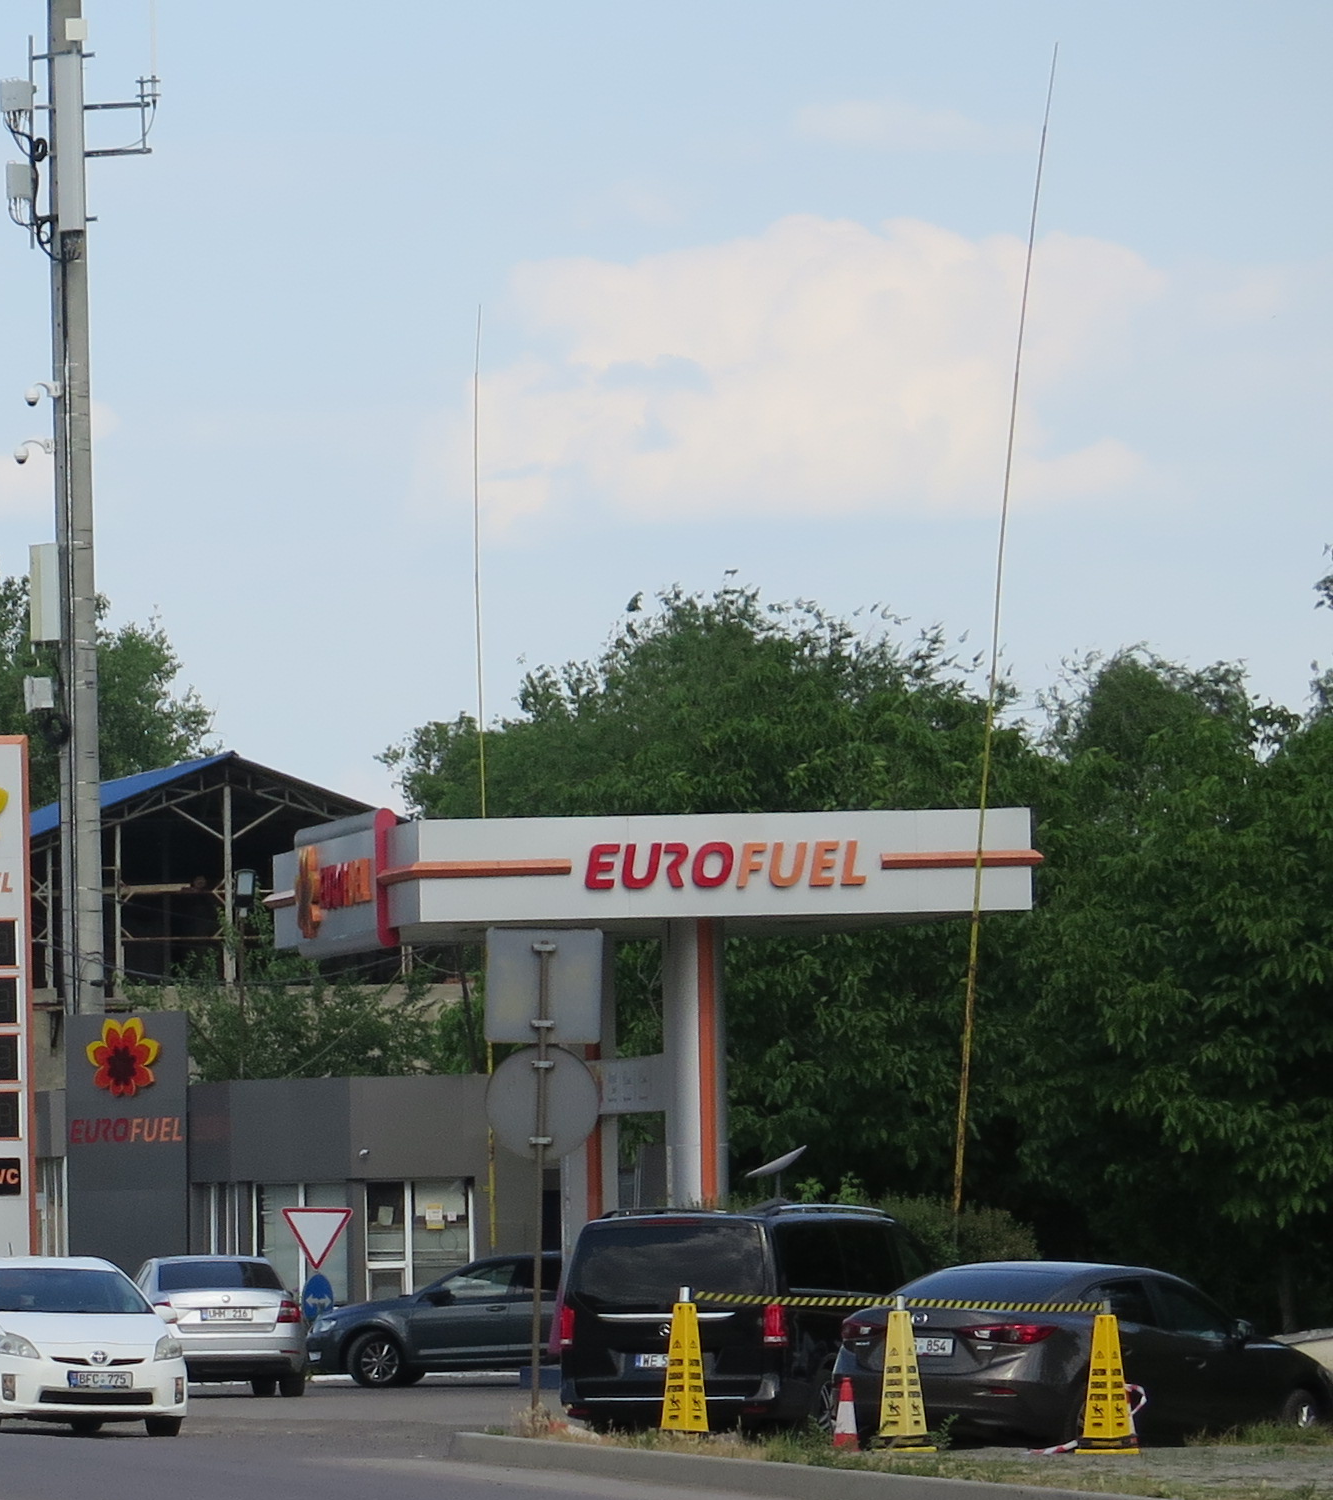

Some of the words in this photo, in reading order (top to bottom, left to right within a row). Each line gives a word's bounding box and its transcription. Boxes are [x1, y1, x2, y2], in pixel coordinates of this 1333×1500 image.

[584, 840, 866, 889] EUROFUEL
[70, 1117, 183, 1143] EUROFUEL
[926, 1340, 946, 1352] 854
[643, 1355, 658, 1367] WE
[79, 1374, 99, 1384] BFC
[108, 1374, 126, 1384] 775
